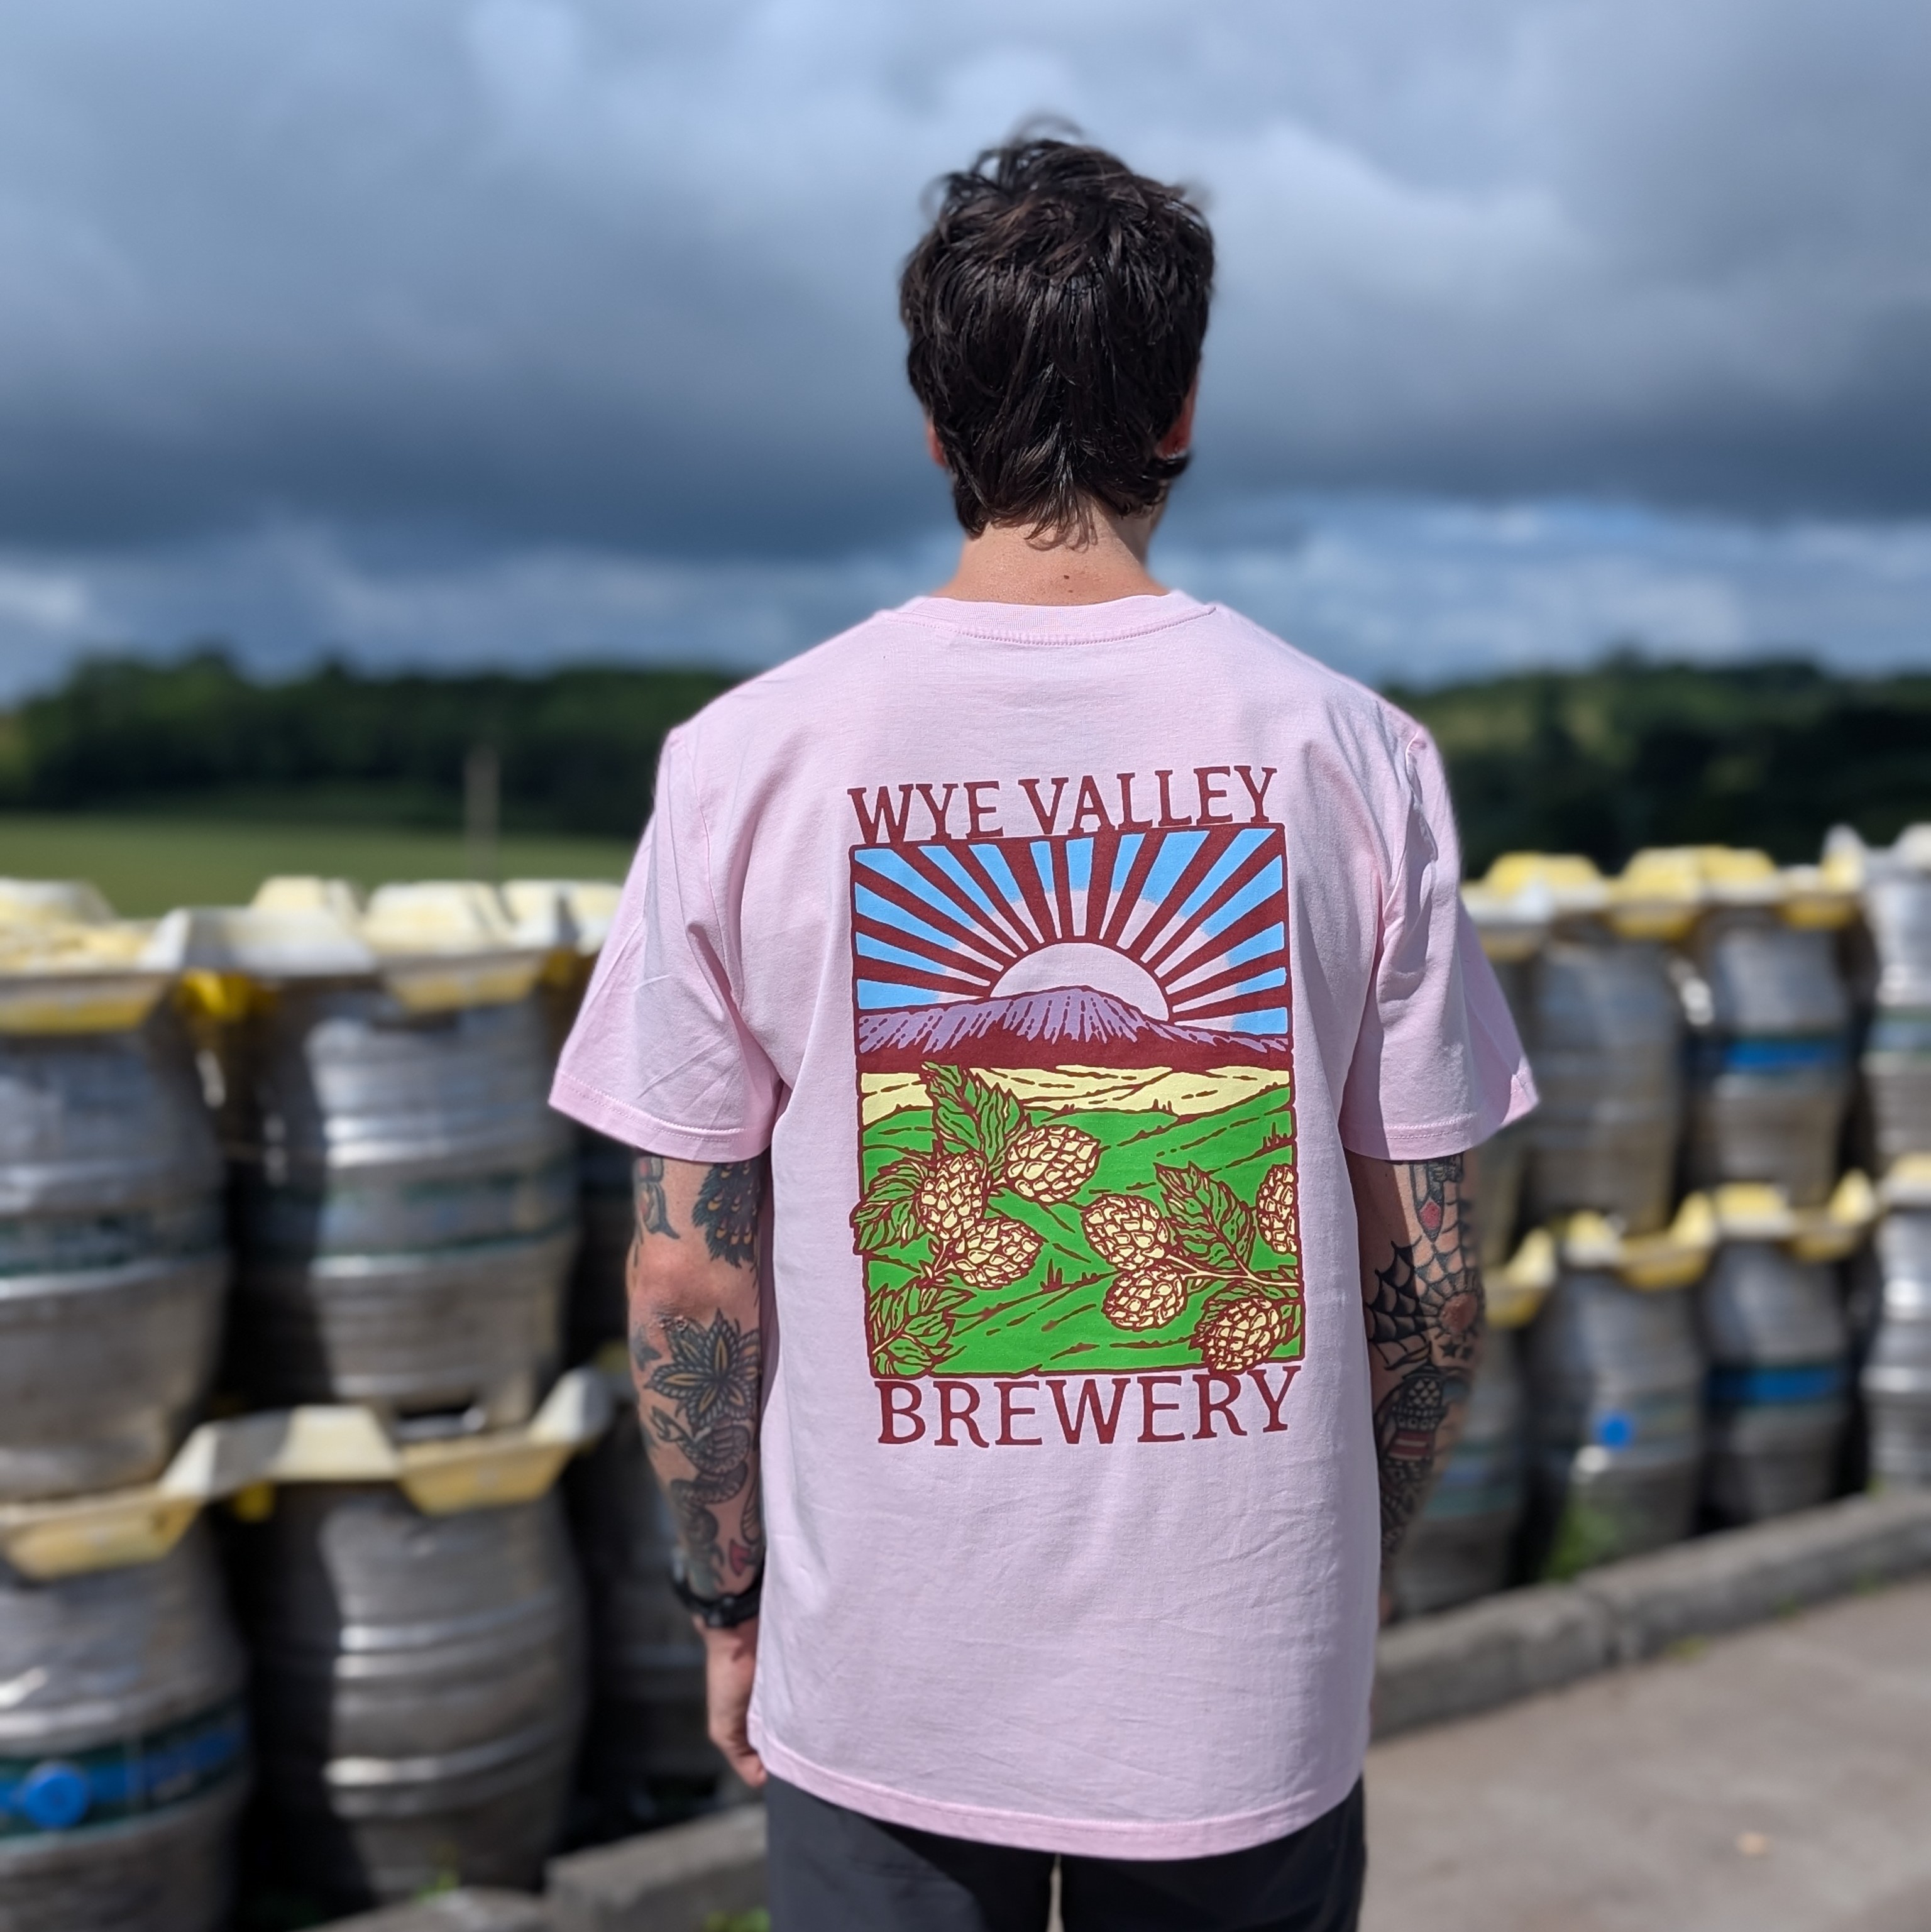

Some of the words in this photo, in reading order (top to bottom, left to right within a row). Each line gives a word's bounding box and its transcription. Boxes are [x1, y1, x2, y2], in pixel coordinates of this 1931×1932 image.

[847, 781, 1004, 843] WYE
[1018, 766, 1277, 835] VALLEY
[874, 1365, 1302, 1448] BREWERY
